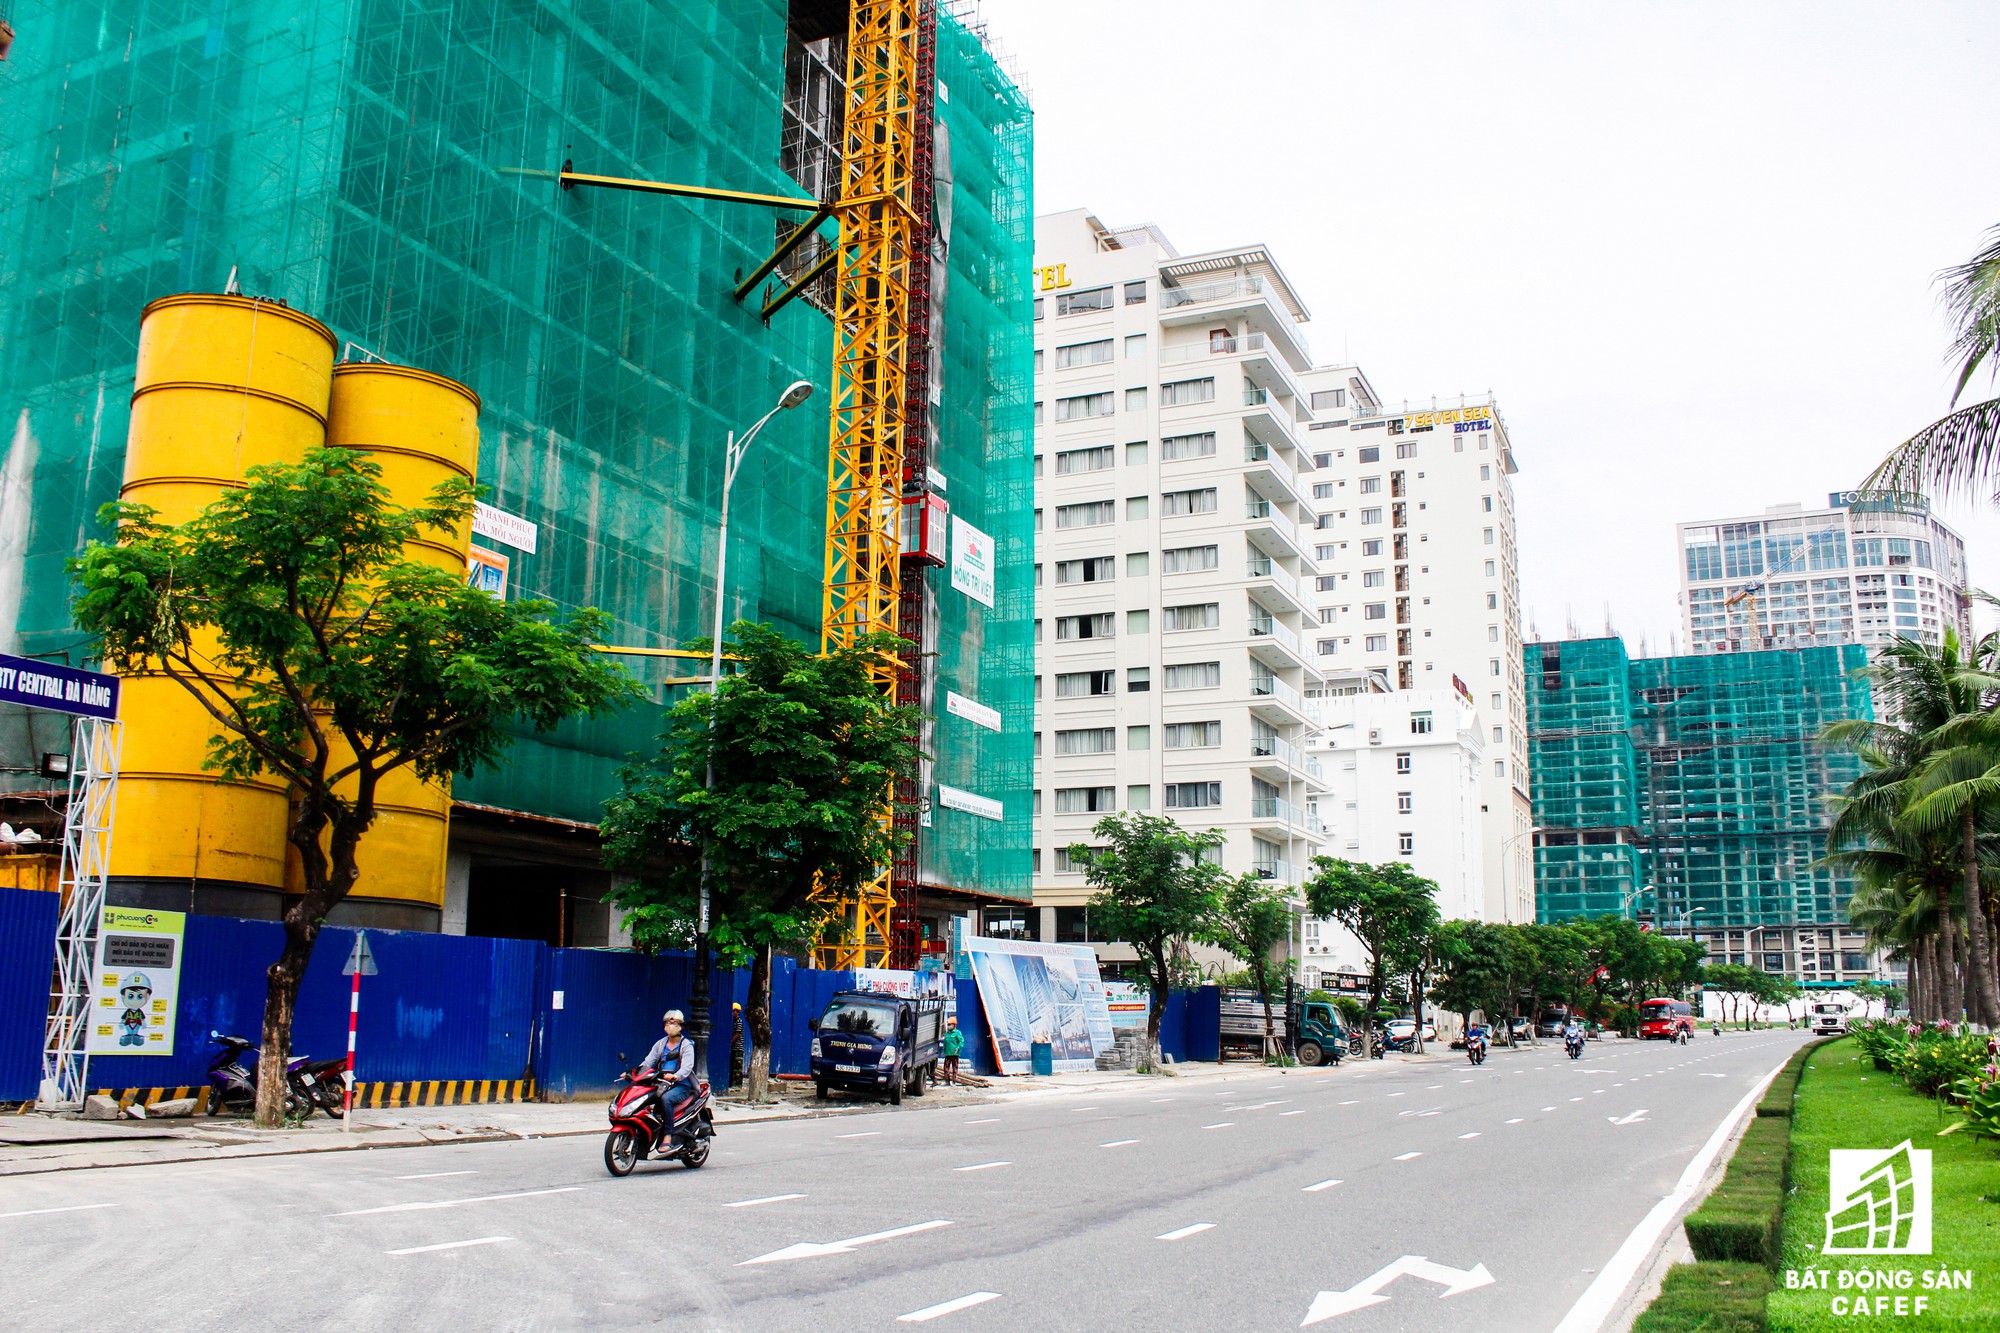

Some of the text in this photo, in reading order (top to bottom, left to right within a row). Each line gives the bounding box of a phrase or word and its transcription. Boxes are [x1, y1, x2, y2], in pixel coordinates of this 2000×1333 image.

[1033, 263, 1072, 291] EL
[1405, 406, 1491, 428] 7 SEVEN SEA
[1454, 420, 1492, 434] HOTEL
[472, 518, 488, 533] HÀ,
[18, 671, 63, 699] CENTRAL
[65, 678, 80, 703] ĐÀ
[82, 678, 111, 708] NẴNG
